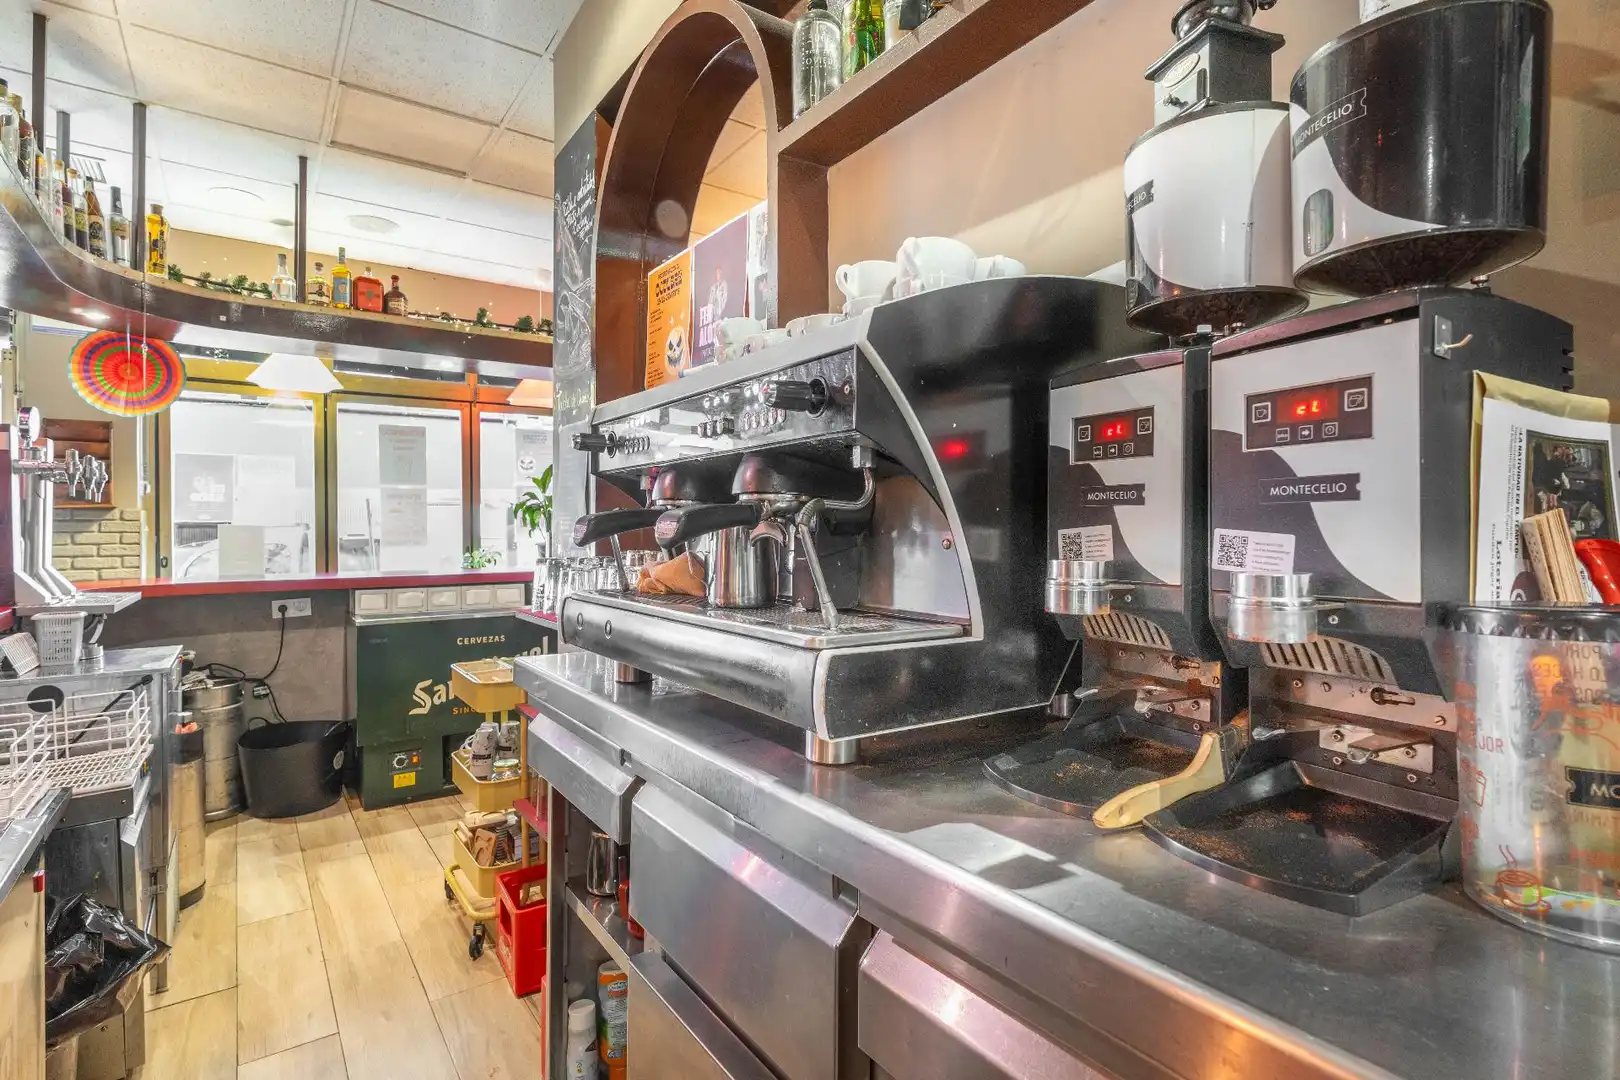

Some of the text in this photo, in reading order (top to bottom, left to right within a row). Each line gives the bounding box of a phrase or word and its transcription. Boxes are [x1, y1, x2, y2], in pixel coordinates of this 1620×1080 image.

[1269, 482, 1348, 496] MONTECELIO
[1087, 490, 1137, 501] MONTECELIO
[456, 635, 506, 645] CERVEZAS
[1476, 735, 1505, 754] JOR
